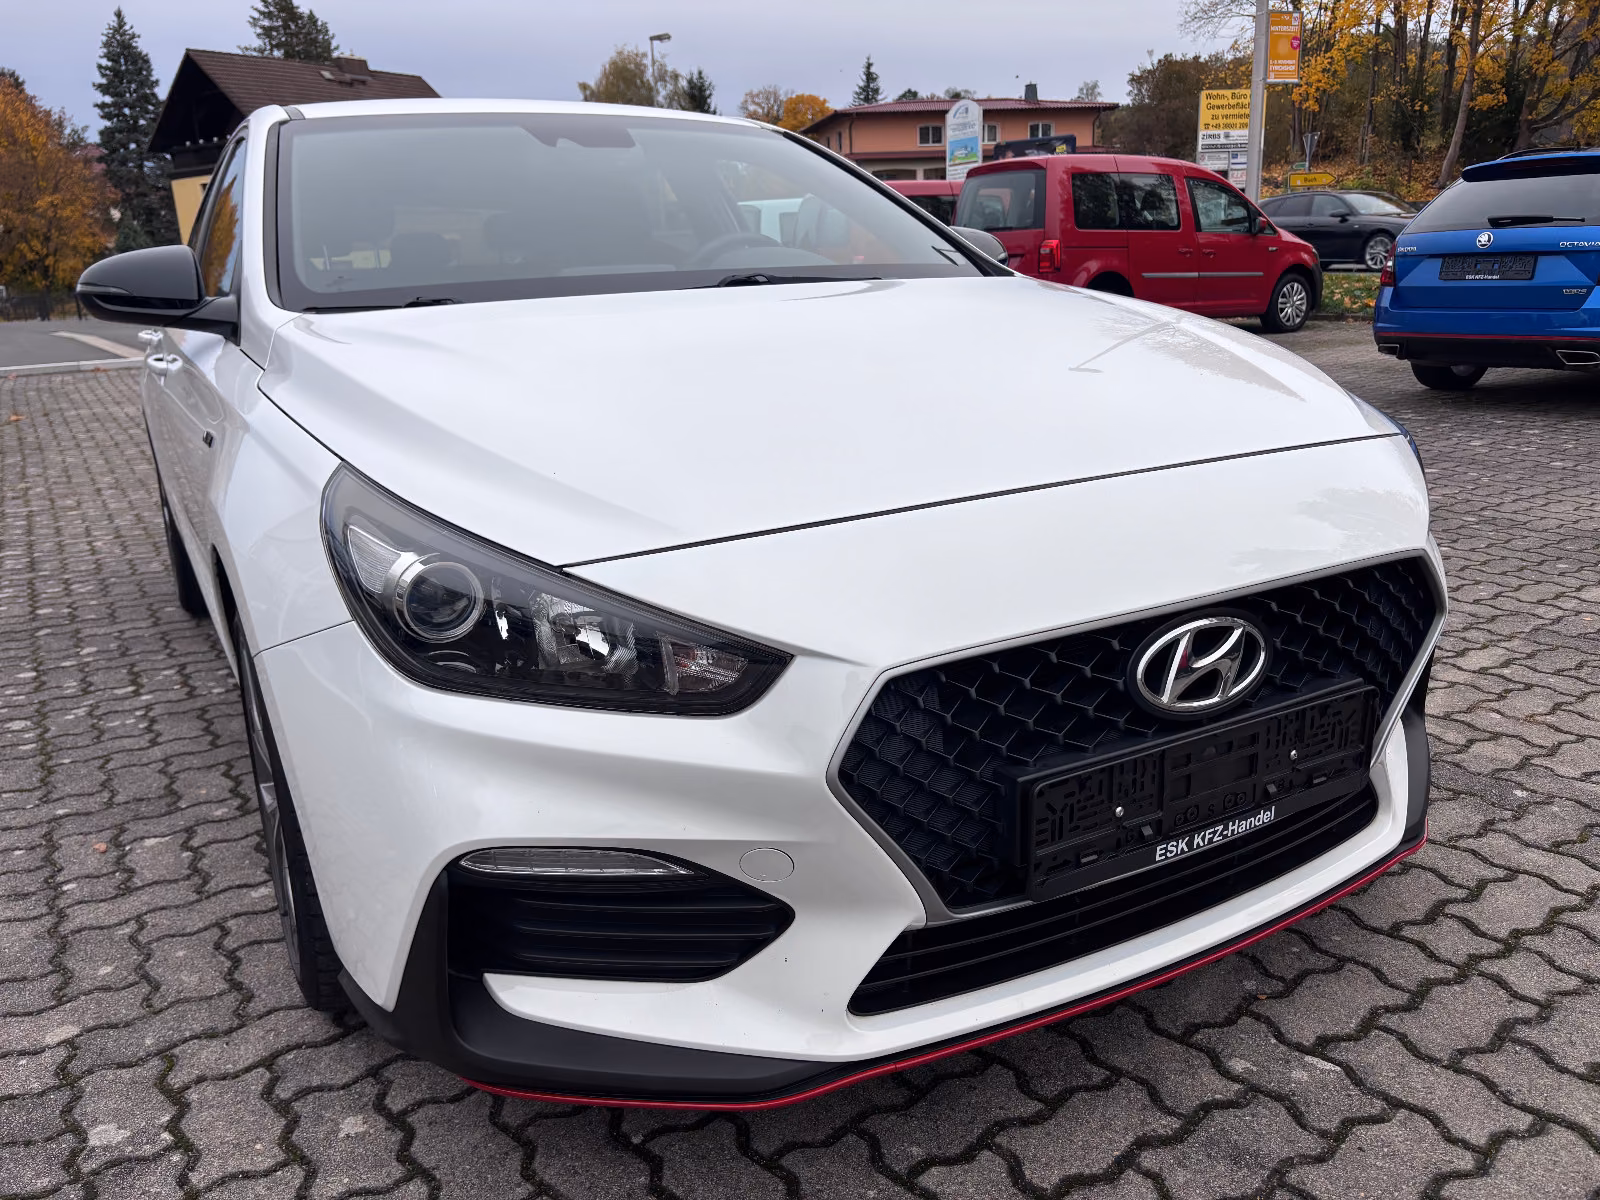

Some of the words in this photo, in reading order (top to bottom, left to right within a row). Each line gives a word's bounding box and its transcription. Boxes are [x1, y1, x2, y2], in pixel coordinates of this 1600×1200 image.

[1231, 92, 1248, 100] Büro
[1221, 112, 1251, 120] vermiete
[1155, 837, 1190, 861] ESK
[1193, 806, 1276, 849] KFZ-Handel
